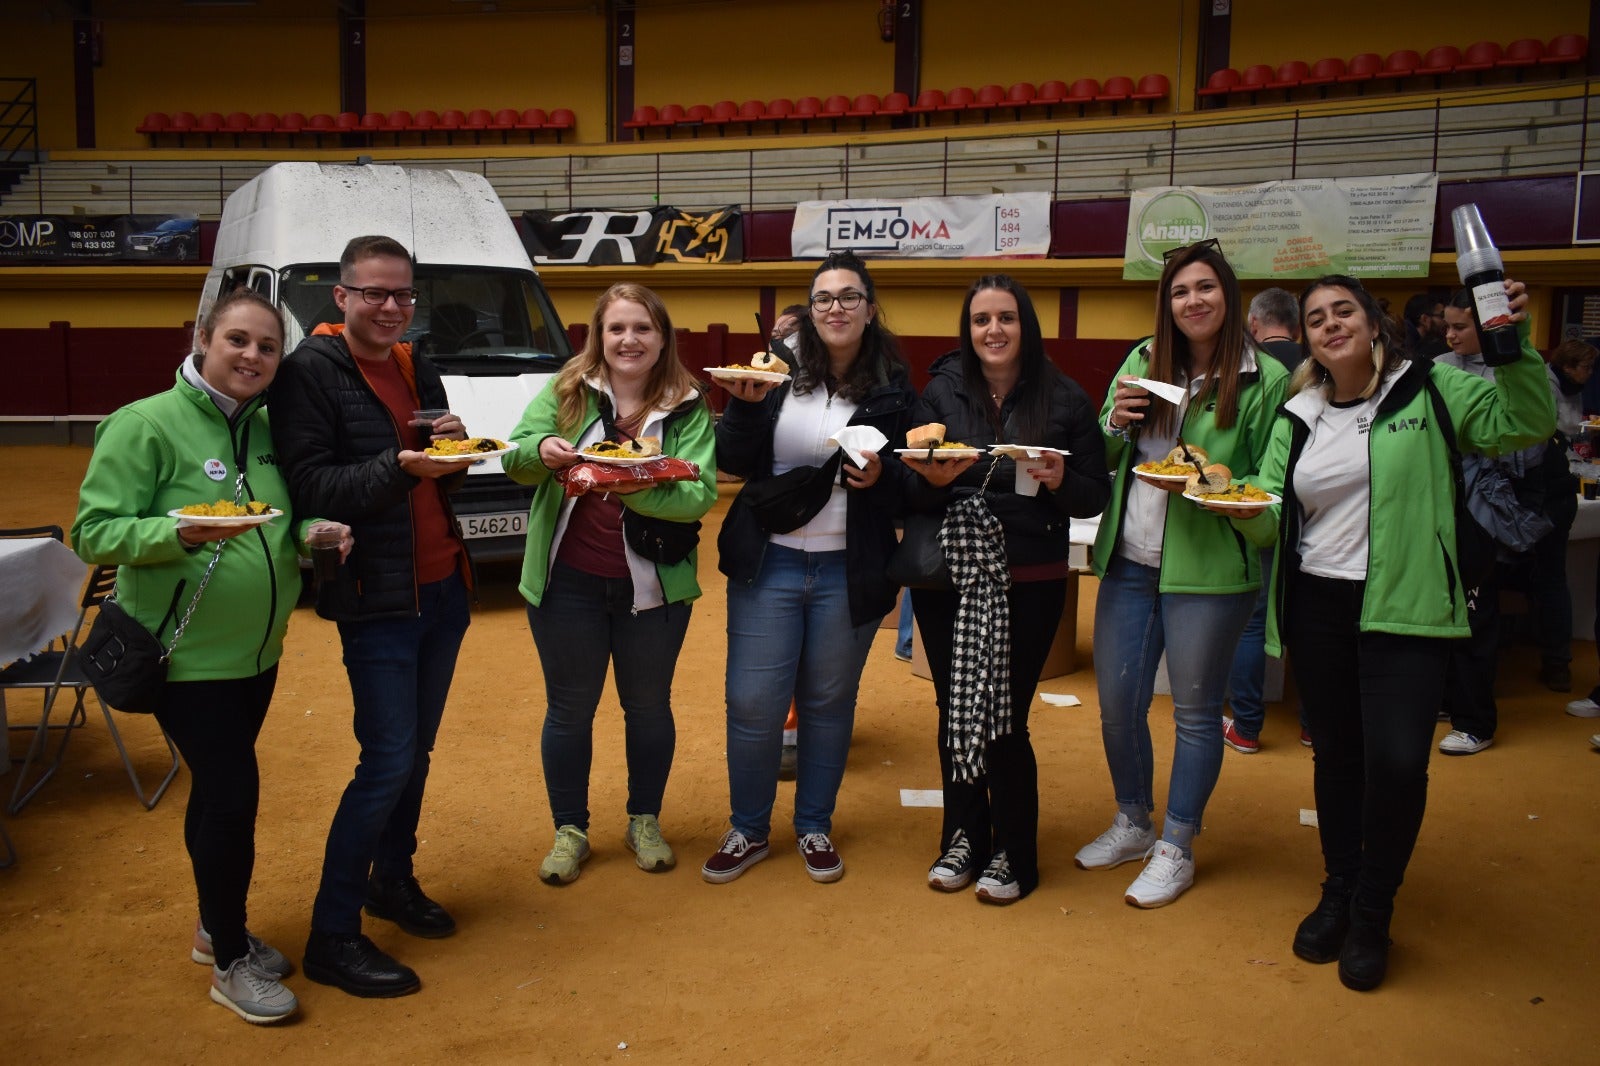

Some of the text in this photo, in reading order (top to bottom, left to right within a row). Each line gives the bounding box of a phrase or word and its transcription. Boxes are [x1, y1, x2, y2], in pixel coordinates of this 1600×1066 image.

[902, 3, 910, 17] 2
[622, 25, 630, 37] 2
[79, 32, 87, 44] 2
[353, 32, 361, 44] 2
[1000, 208, 1020, 219] 645
[20, 221, 54, 246] MP
[838, 218, 951, 240] EMJOMA
[1000, 222, 1020, 233] 484
[1141, 222, 1203, 244] Anaya
[84, 241, 99, 249] 433
[1000, 237, 1020, 248] 587
[1287, 236, 1313, 246] DONDE
[901, 243, 932, 253] Servicios
[1277, 243, 1323, 255] LA CALIDAD
[1388, 417, 1428, 434] NATA
